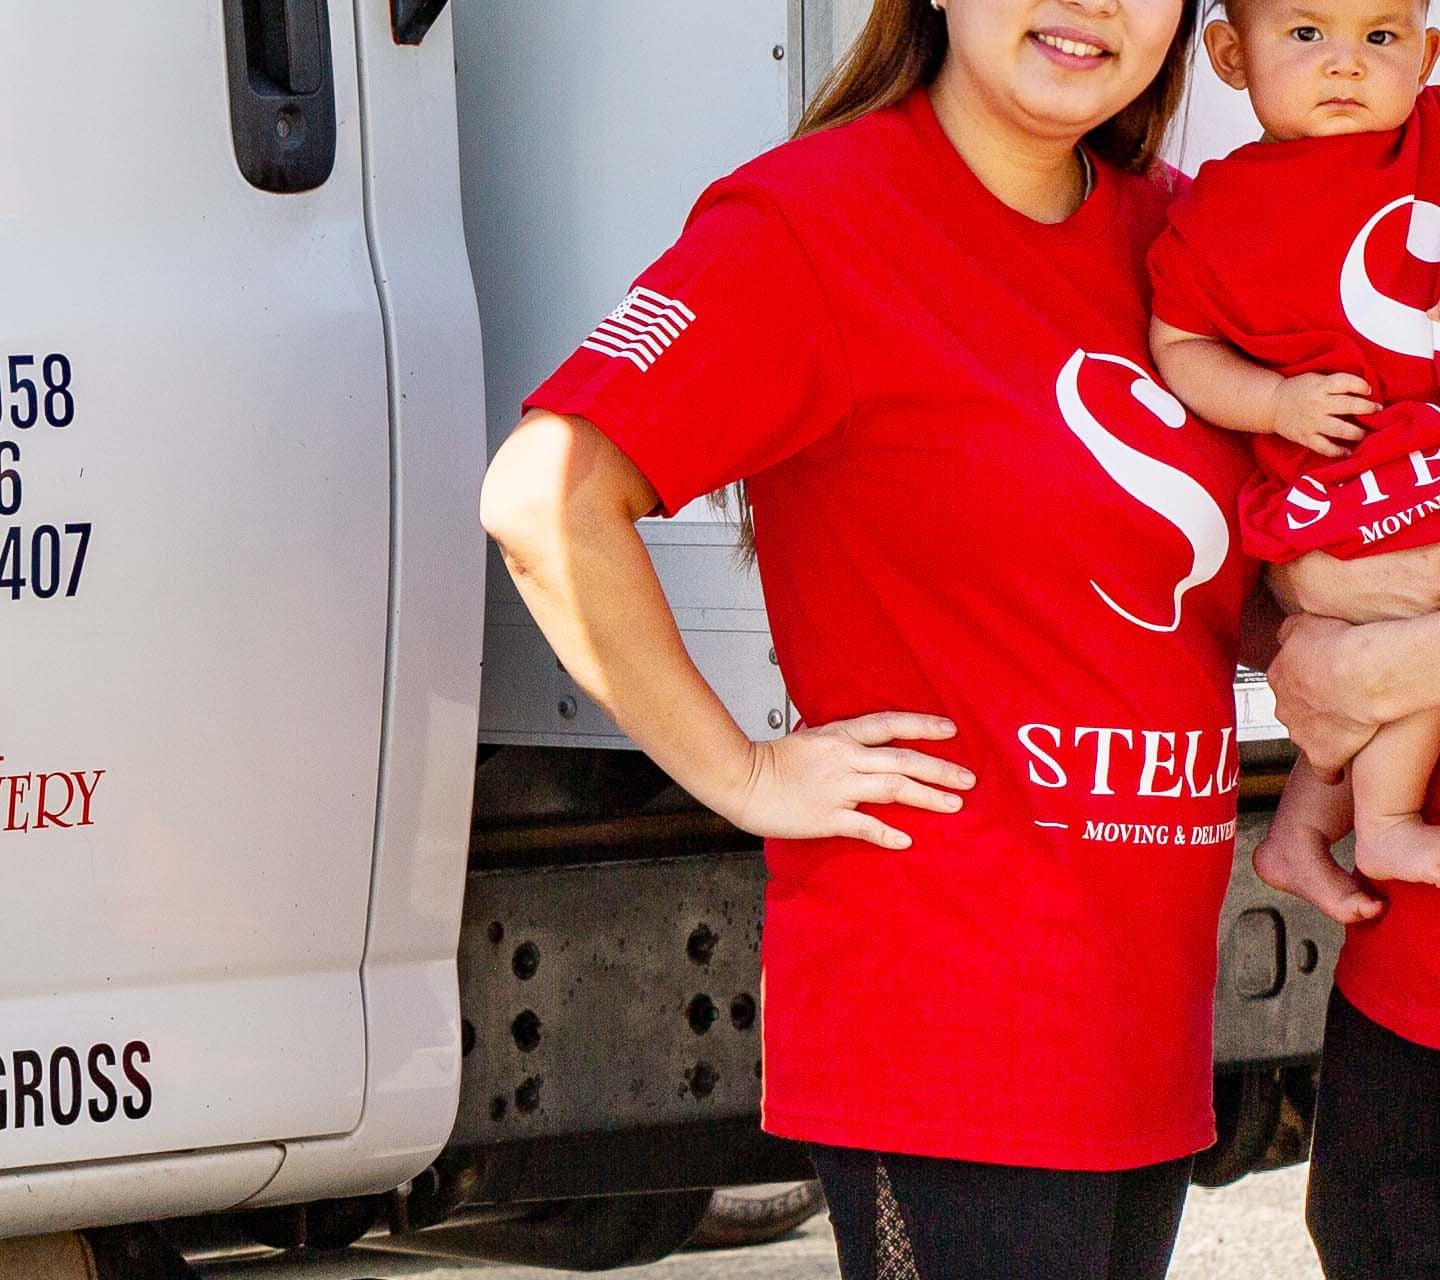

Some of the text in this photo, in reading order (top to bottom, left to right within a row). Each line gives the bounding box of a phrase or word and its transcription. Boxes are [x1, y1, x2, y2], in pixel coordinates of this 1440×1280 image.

[1055, 348, 1230, 632] S
[1017, 723, 1239, 798] STELL
[1081, 820, 1169, 845] MOVING
[1174, 825, 1186, 845] &
